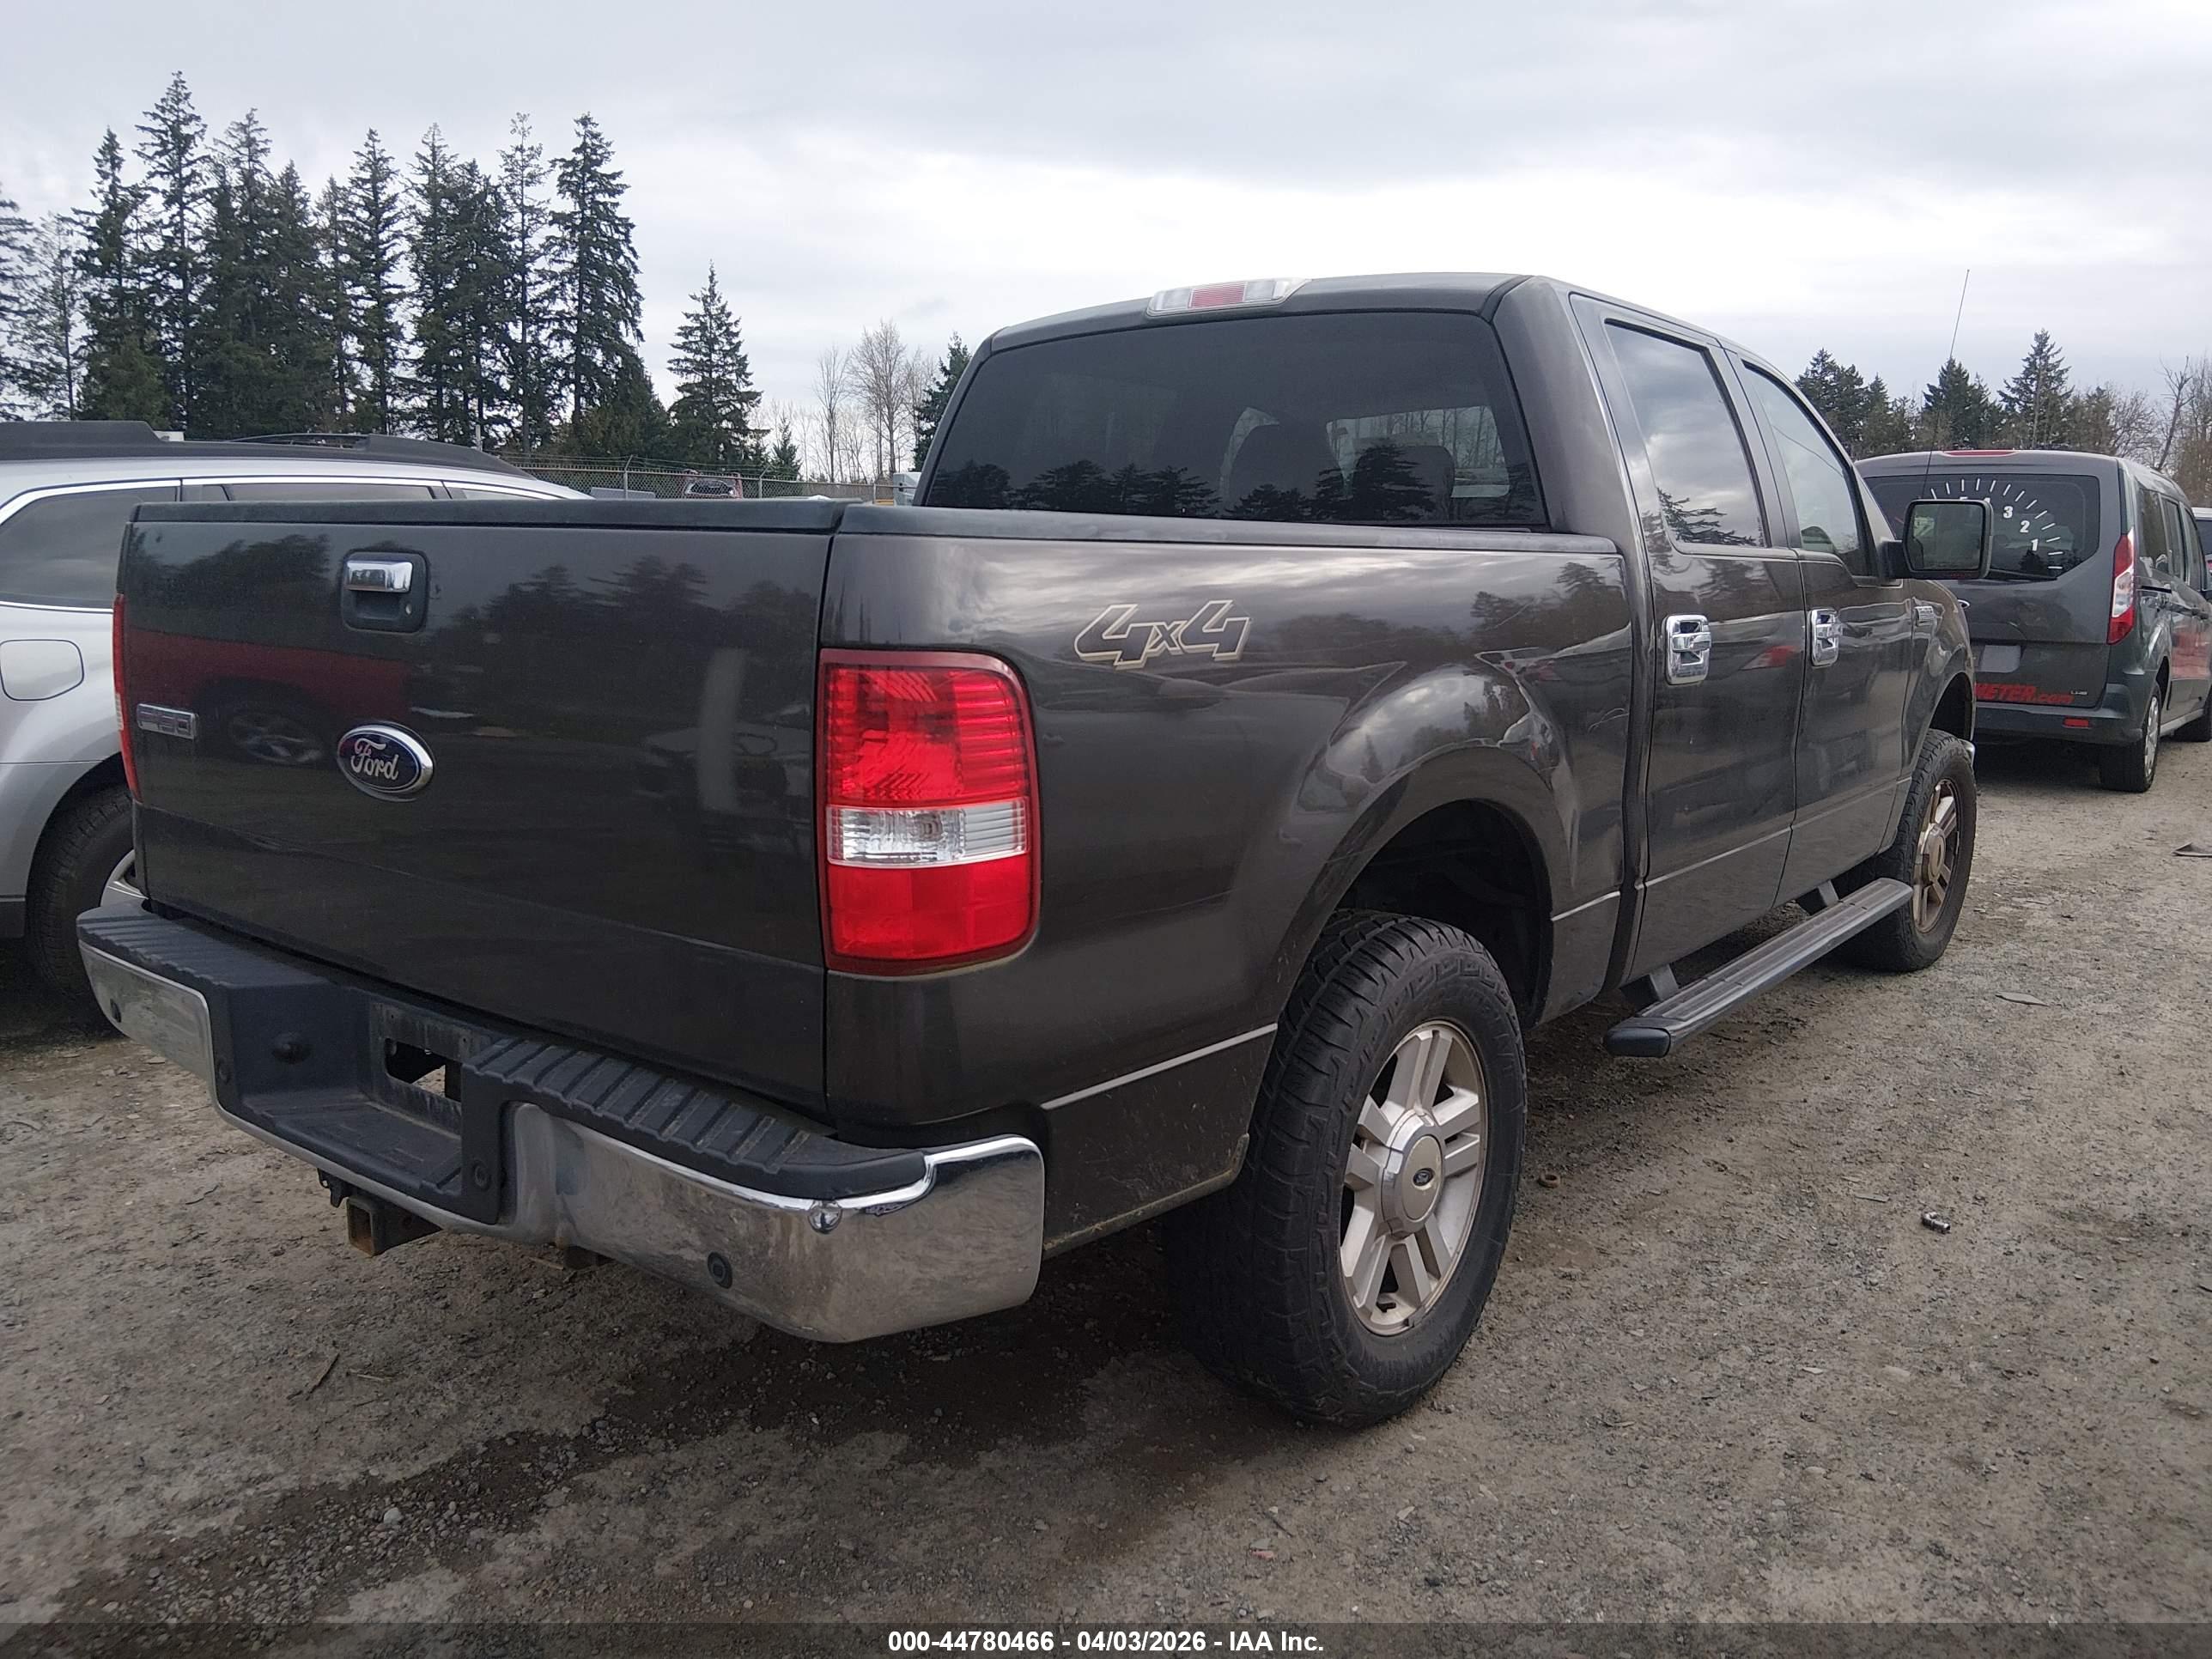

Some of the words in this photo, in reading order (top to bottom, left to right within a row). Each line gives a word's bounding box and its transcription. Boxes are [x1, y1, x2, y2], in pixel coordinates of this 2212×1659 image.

[2002, 505, 2014, 519] 3
[2019, 520, 2031, 533] 2
[2031, 538, 2039, 551] 1
[1073, 599, 1252, 671] 4x4
[350, 738, 399, 780] Ford
